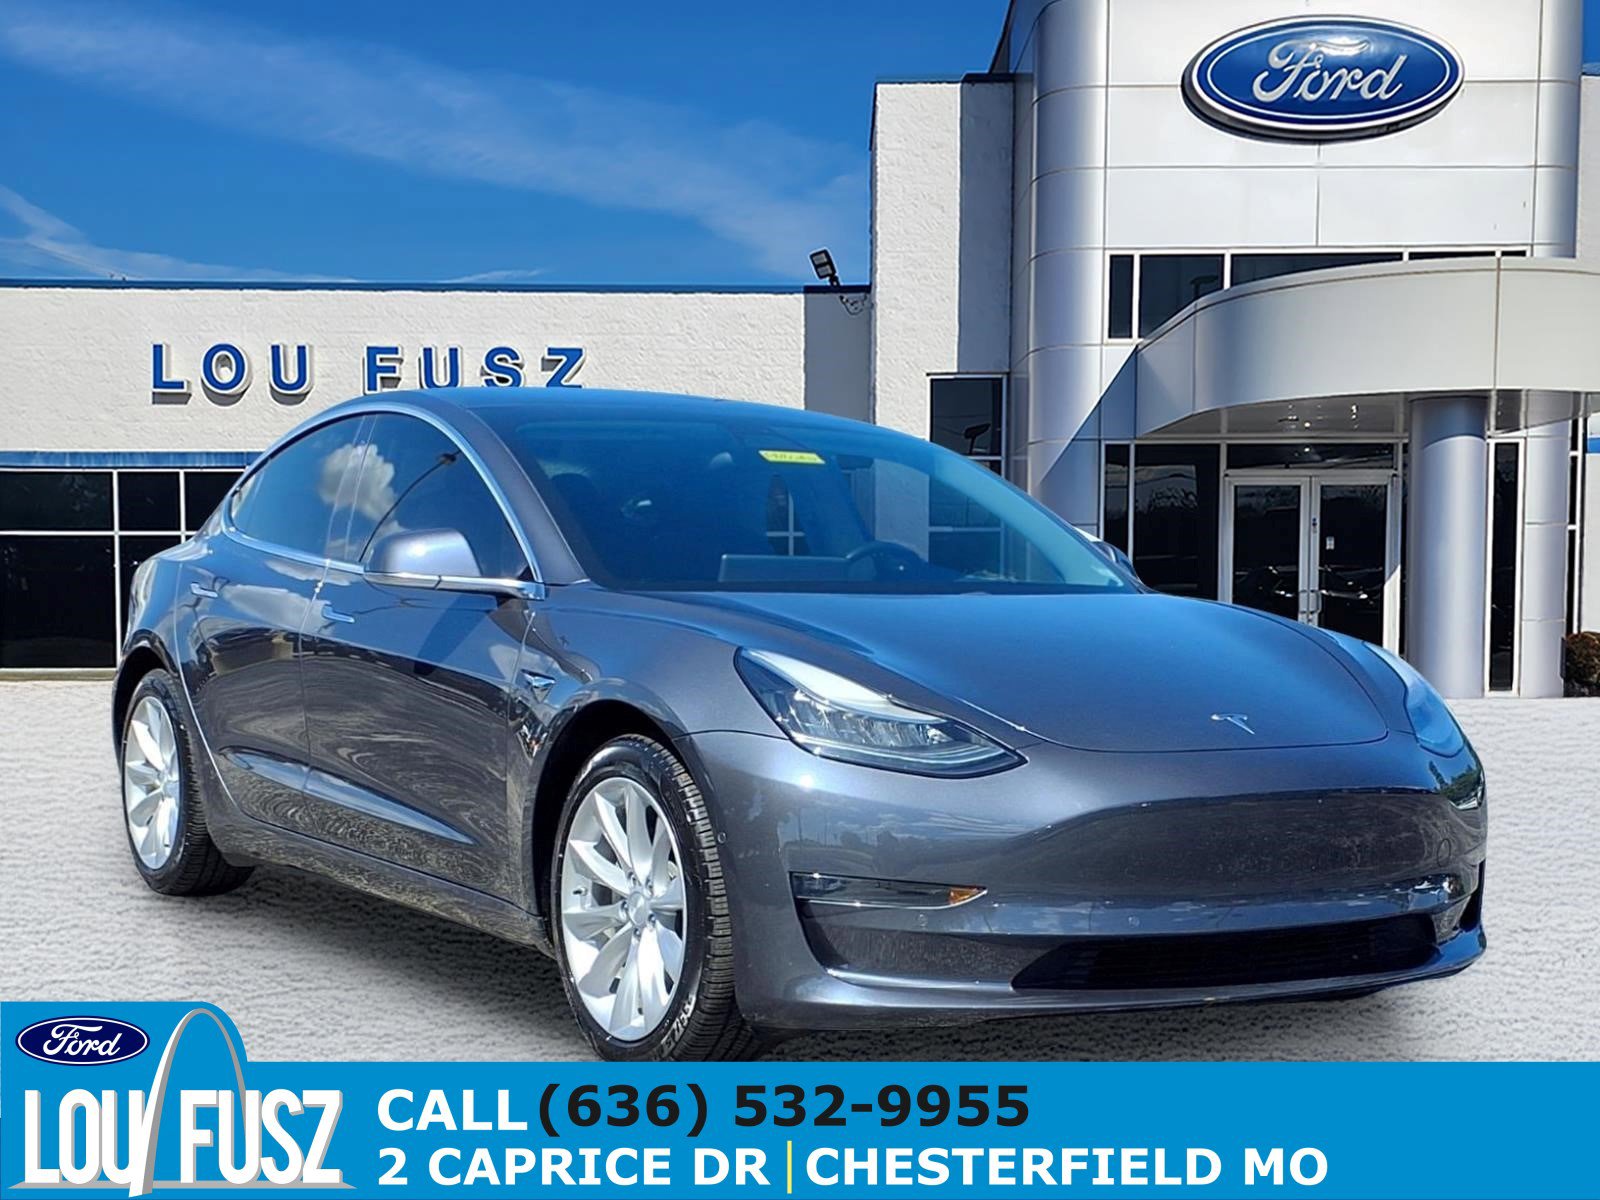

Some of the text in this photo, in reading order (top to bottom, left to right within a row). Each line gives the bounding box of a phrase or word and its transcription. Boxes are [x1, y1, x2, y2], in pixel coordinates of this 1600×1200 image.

[1252, 37, 1407, 102] Ford
[151, 343, 586, 393] LOU FUSZ
